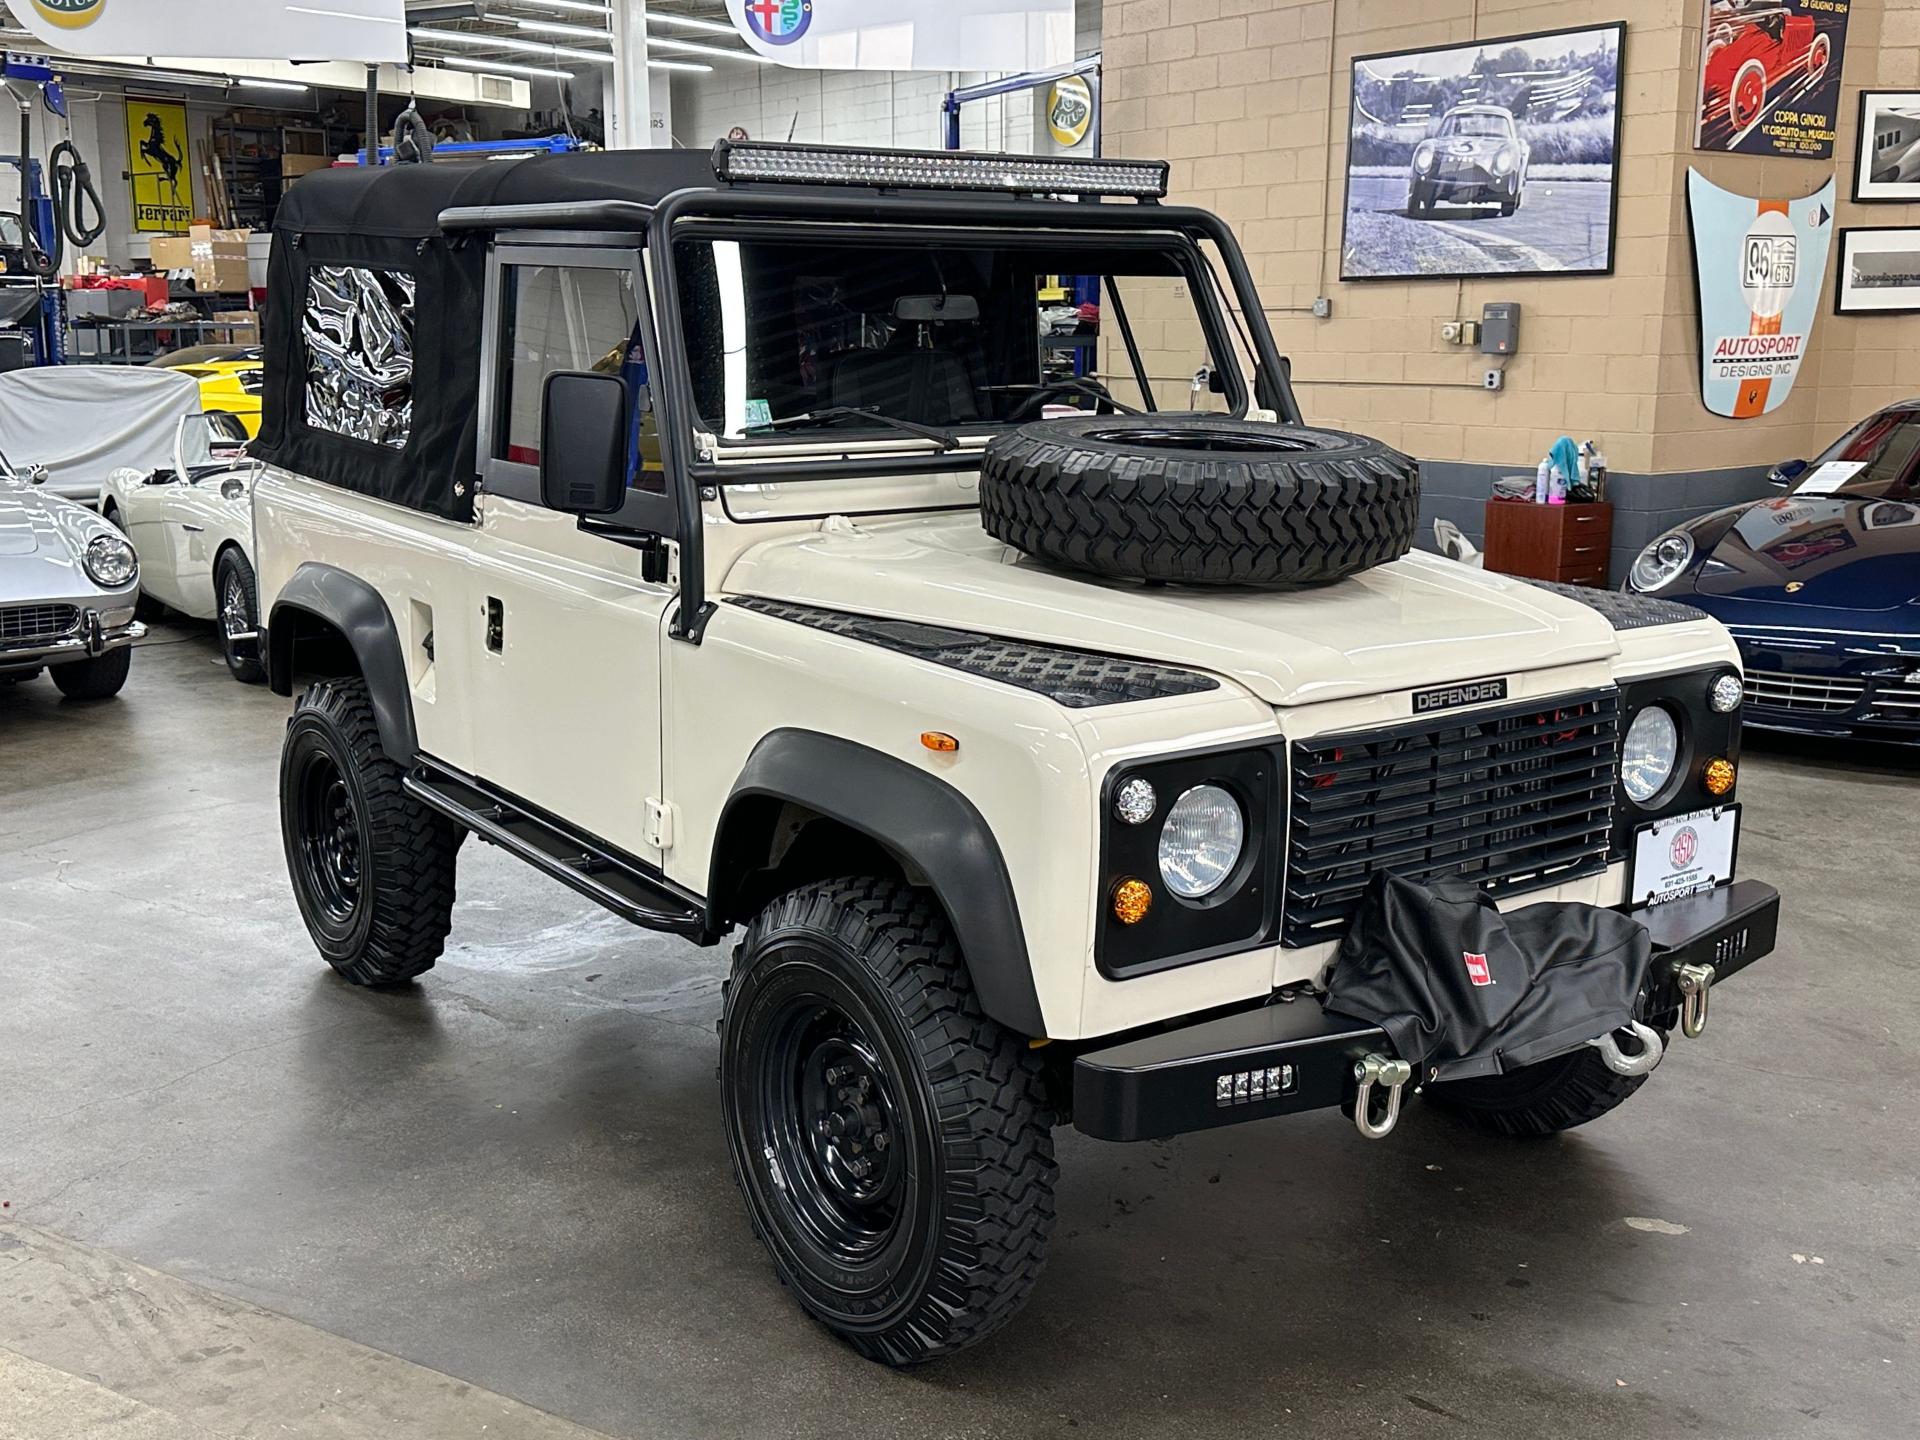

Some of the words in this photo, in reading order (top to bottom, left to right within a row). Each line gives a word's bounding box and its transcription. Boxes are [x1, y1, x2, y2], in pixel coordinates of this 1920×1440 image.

[1774, 110, 1799, 125] COPPA
[1800, 113, 1827, 128] GINORI
[1808, 129, 1836, 141] MUGELLO
[1749, 242, 1770, 281] 96
[1775, 265, 1790, 282] GT3
[1715, 336, 1802, 356] AUTOSPORT
[1720, 364, 1773, 378] DESIGNS
[1774, 363, 1792, 375] INC
[1417, 682, 1501, 709] DEFENDER
[1648, 886, 1694, 907] AUTOSPORT
